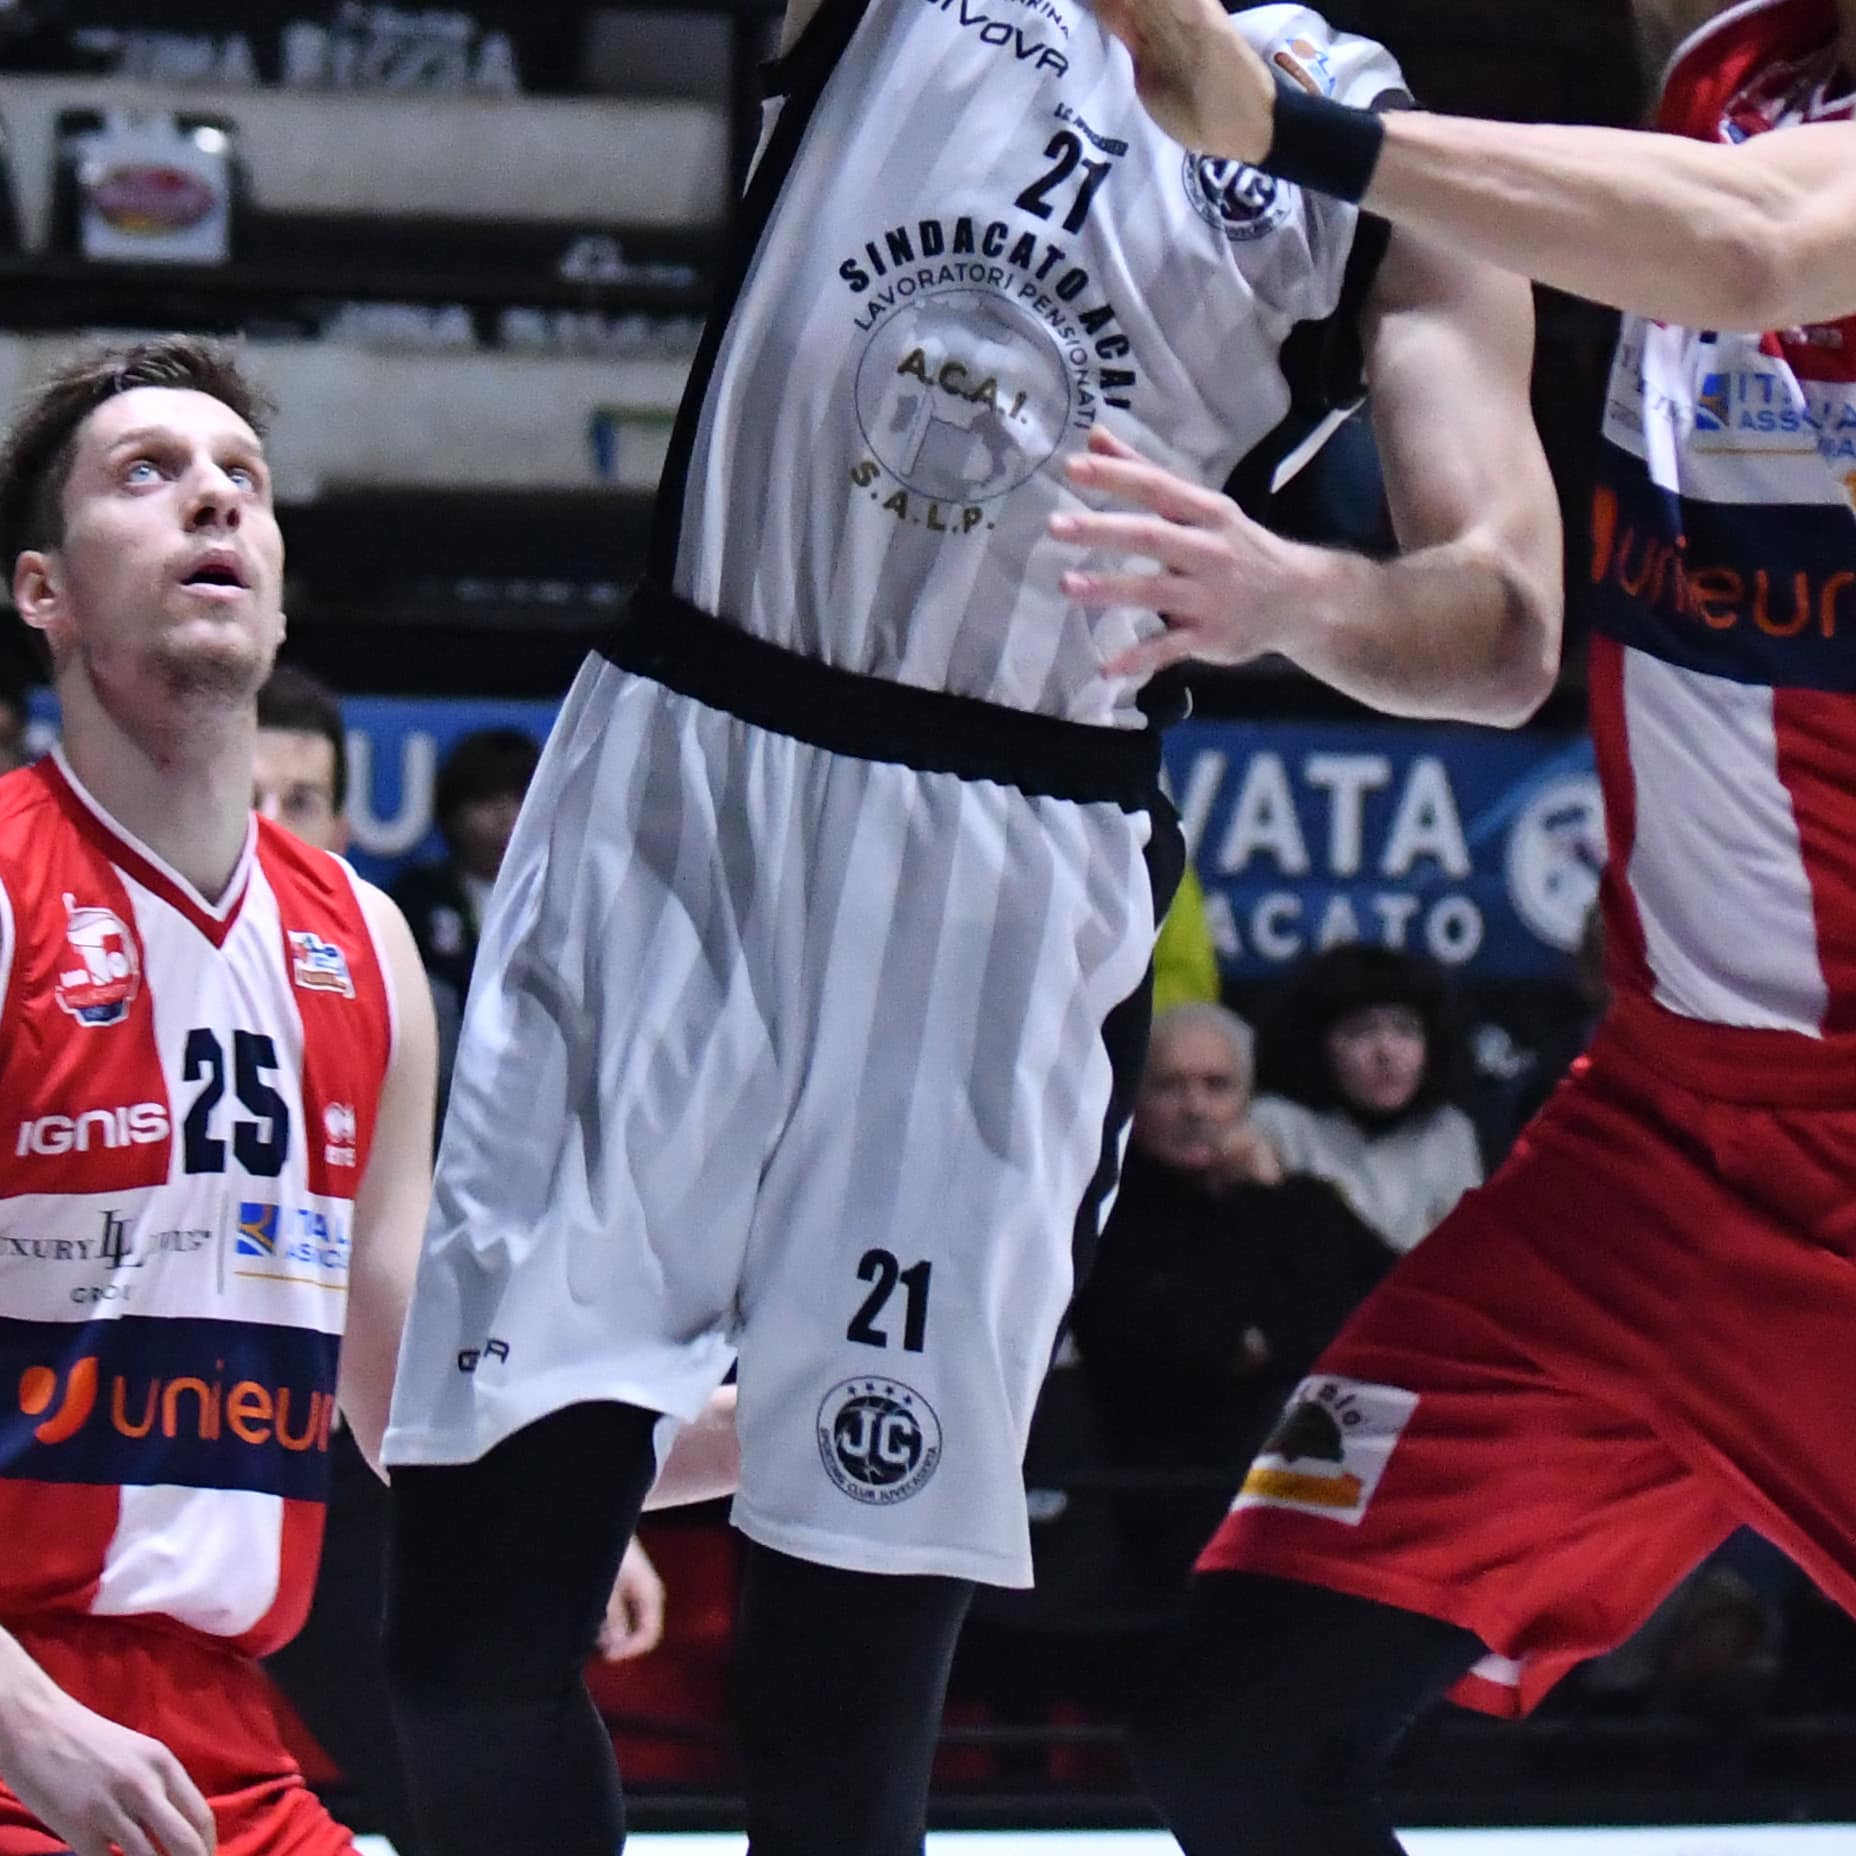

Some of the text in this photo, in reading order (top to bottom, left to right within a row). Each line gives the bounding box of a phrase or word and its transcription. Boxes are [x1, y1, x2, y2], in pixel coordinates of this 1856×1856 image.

[1013, 129, 1113, 235] 21
[839, 216, 1137, 411] SINDACATO ACAI
[853, 262, 1097, 431] LAVORATORI PENSIONATI
[850, 459, 995, 535] S.A.L.P.
[16, 1102, 172, 1157] IGNIS
[182, 1027, 290, 1178] 25
[846, 1247, 932, 1354] 21
[840, 1408, 915, 1465] JC
